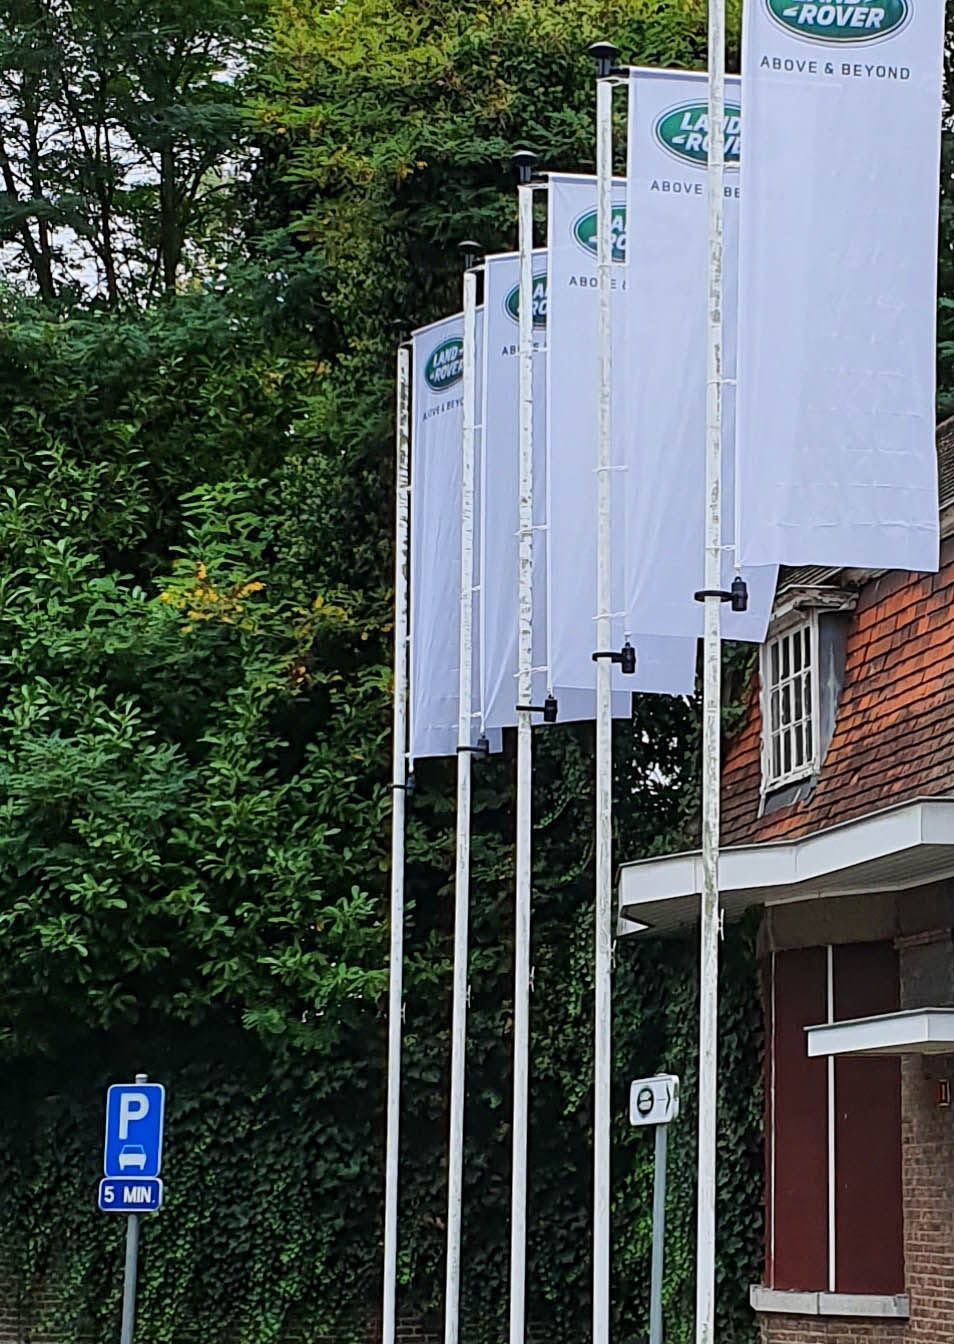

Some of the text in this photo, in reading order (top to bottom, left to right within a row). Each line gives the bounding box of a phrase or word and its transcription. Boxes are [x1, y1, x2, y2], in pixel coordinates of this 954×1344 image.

[797, 6, 885, 29] ROVER
[760, 55, 911, 80] ABOVE & BEYOND
[650, 179, 703, 195] ABOVE
[569, 275, 617, 290] ABOE
[118, 1092, 150, 1140] P
[103, 1186, 115, 1203] 5
